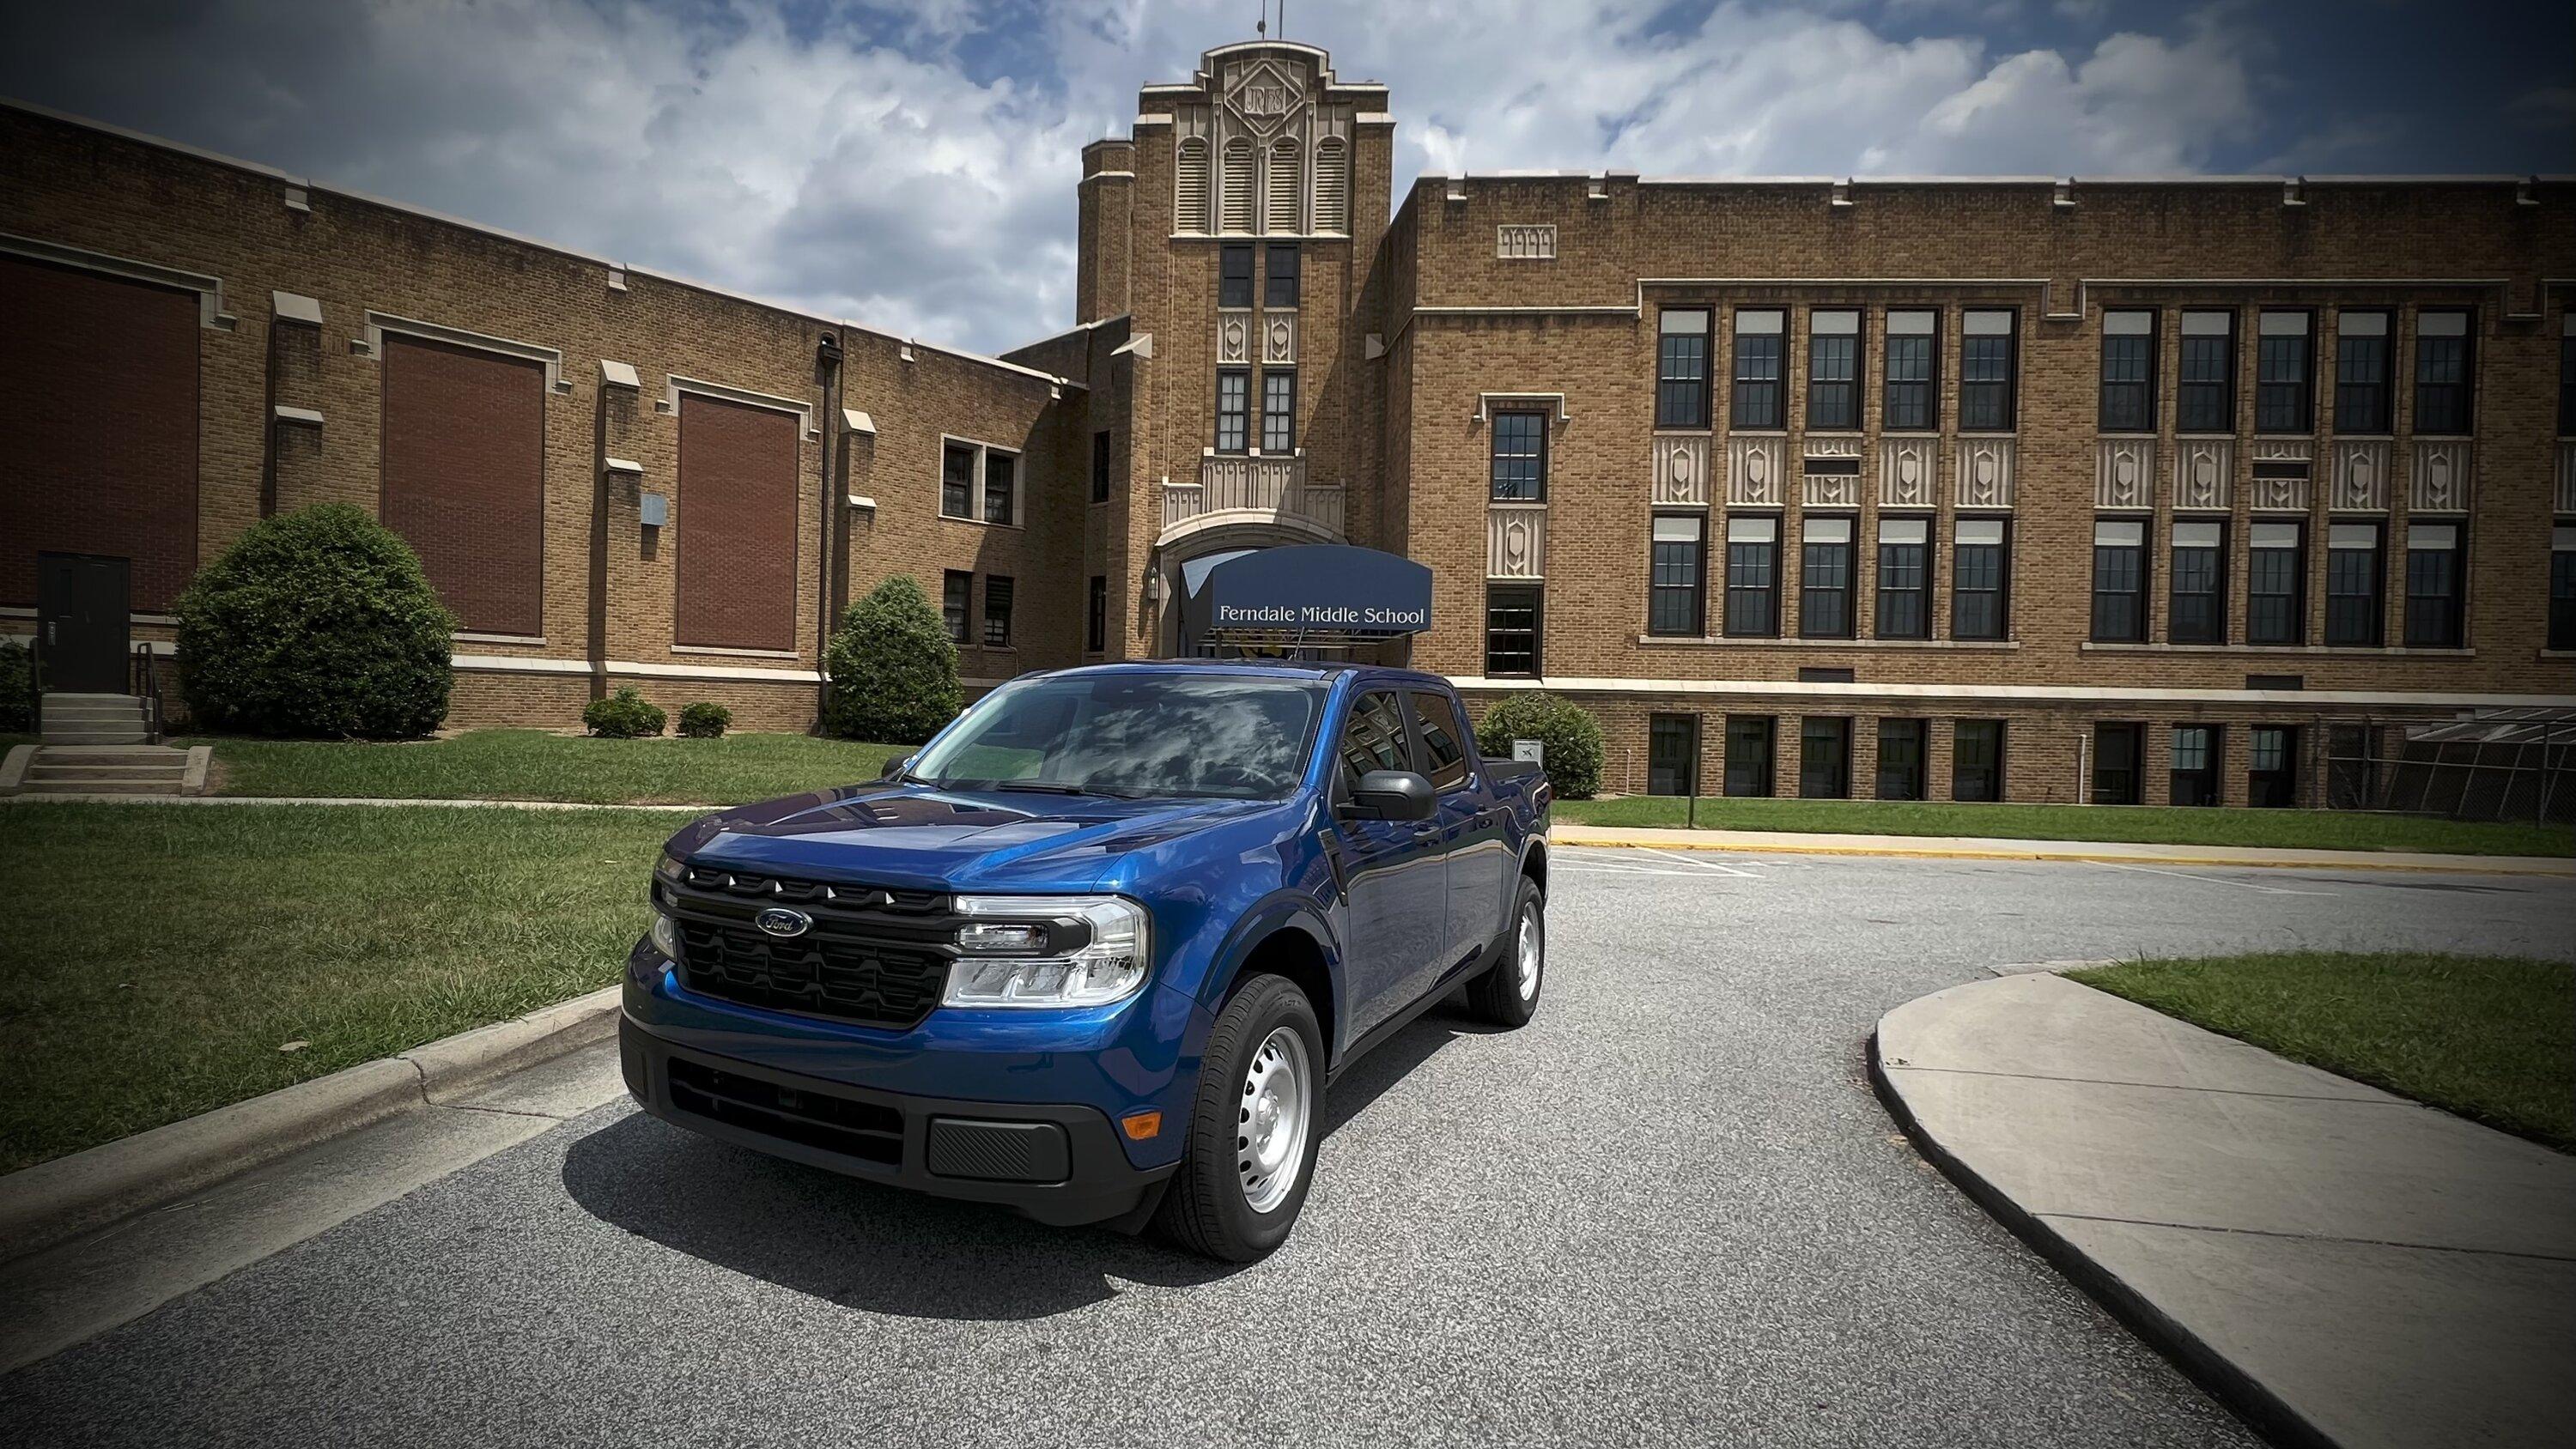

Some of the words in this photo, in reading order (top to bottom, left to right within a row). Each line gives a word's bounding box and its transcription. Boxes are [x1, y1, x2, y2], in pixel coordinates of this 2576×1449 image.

[1220, 605, 1295, 621] Ferndale
[1301, 607, 1358, 623] Middle
[1364, 608, 1425, 624] School
[765, 913, 793, 931] Ford
